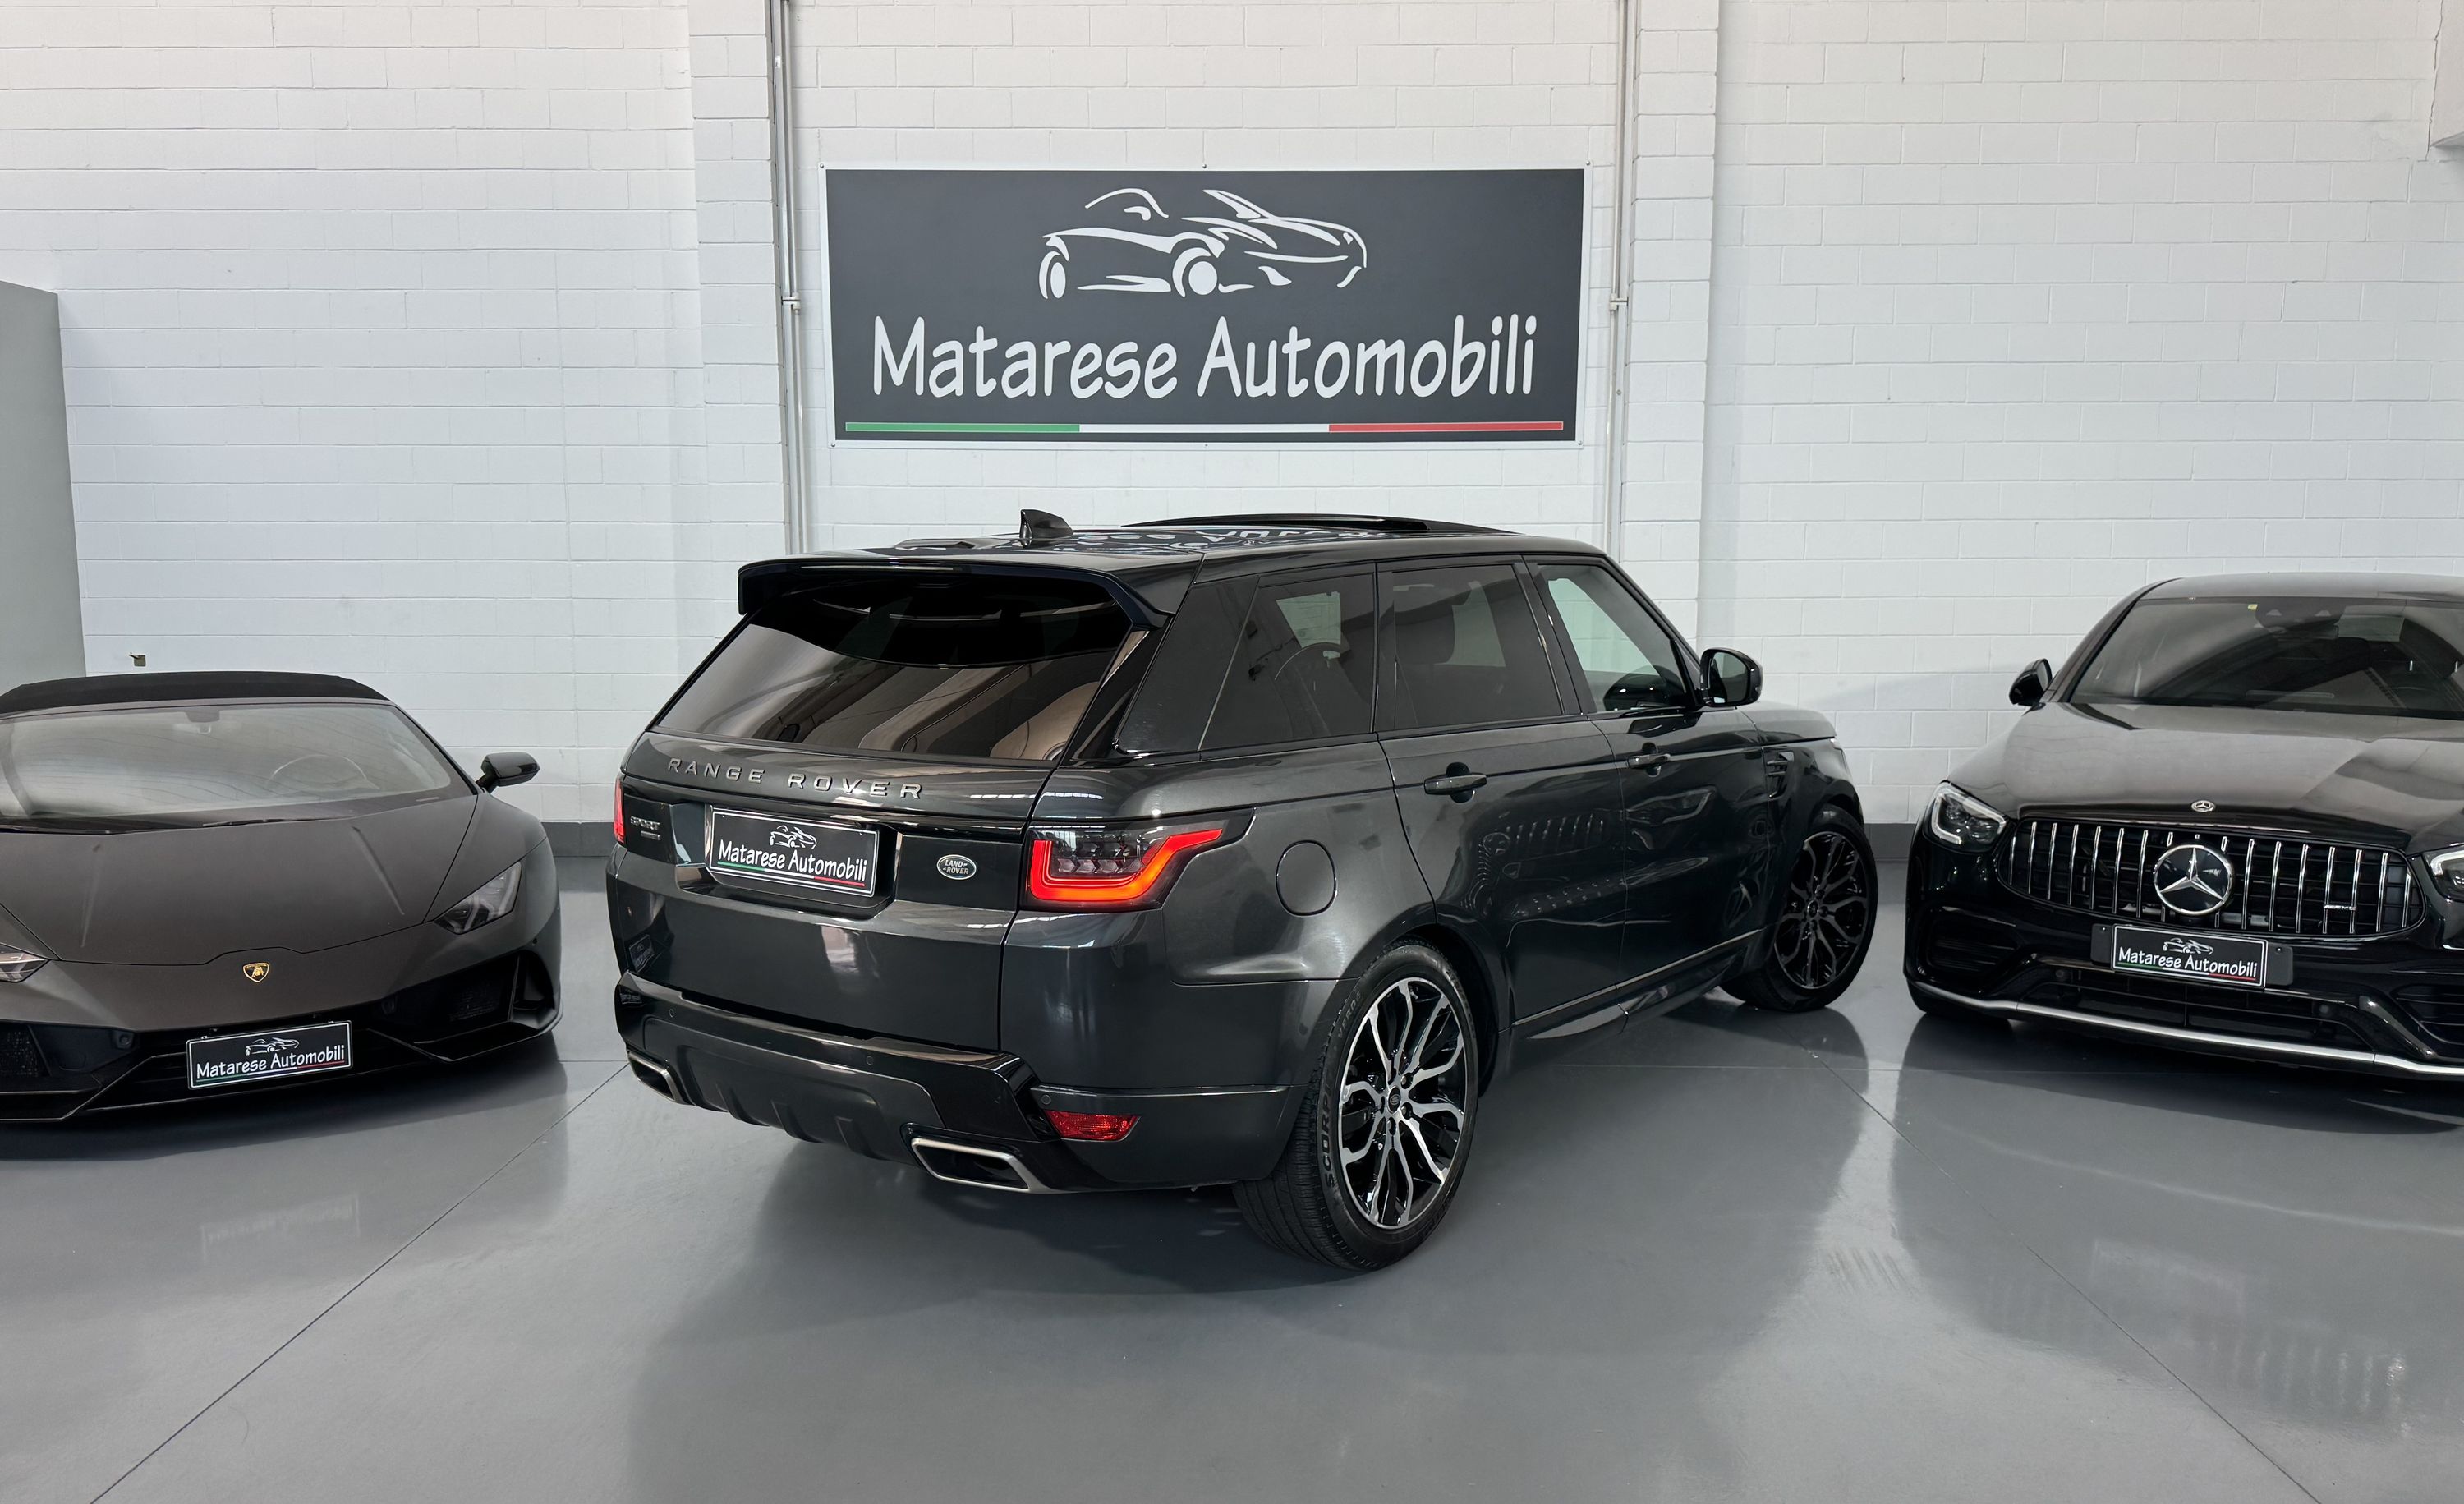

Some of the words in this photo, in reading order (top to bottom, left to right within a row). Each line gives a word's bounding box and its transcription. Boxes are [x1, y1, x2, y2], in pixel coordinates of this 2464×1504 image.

[874, 316, 1177, 398] Matarese
[1197, 314, 1536, 398] Automobili
[667, 757, 765, 784] RANGE
[787, 773, 922, 799] ROVER
[719, 839, 785, 869] Matarese
[788, 849, 867, 881] Automobili
[945, 859, 963, 867] LAND
[946, 867, 969, 875] ROVER
[2118, 946, 2181, 968] Matarese
[2184, 954, 2258, 977] Automobili
[196, 1058, 267, 1079] Matarese
[270, 1044, 345, 1069] Automobili
